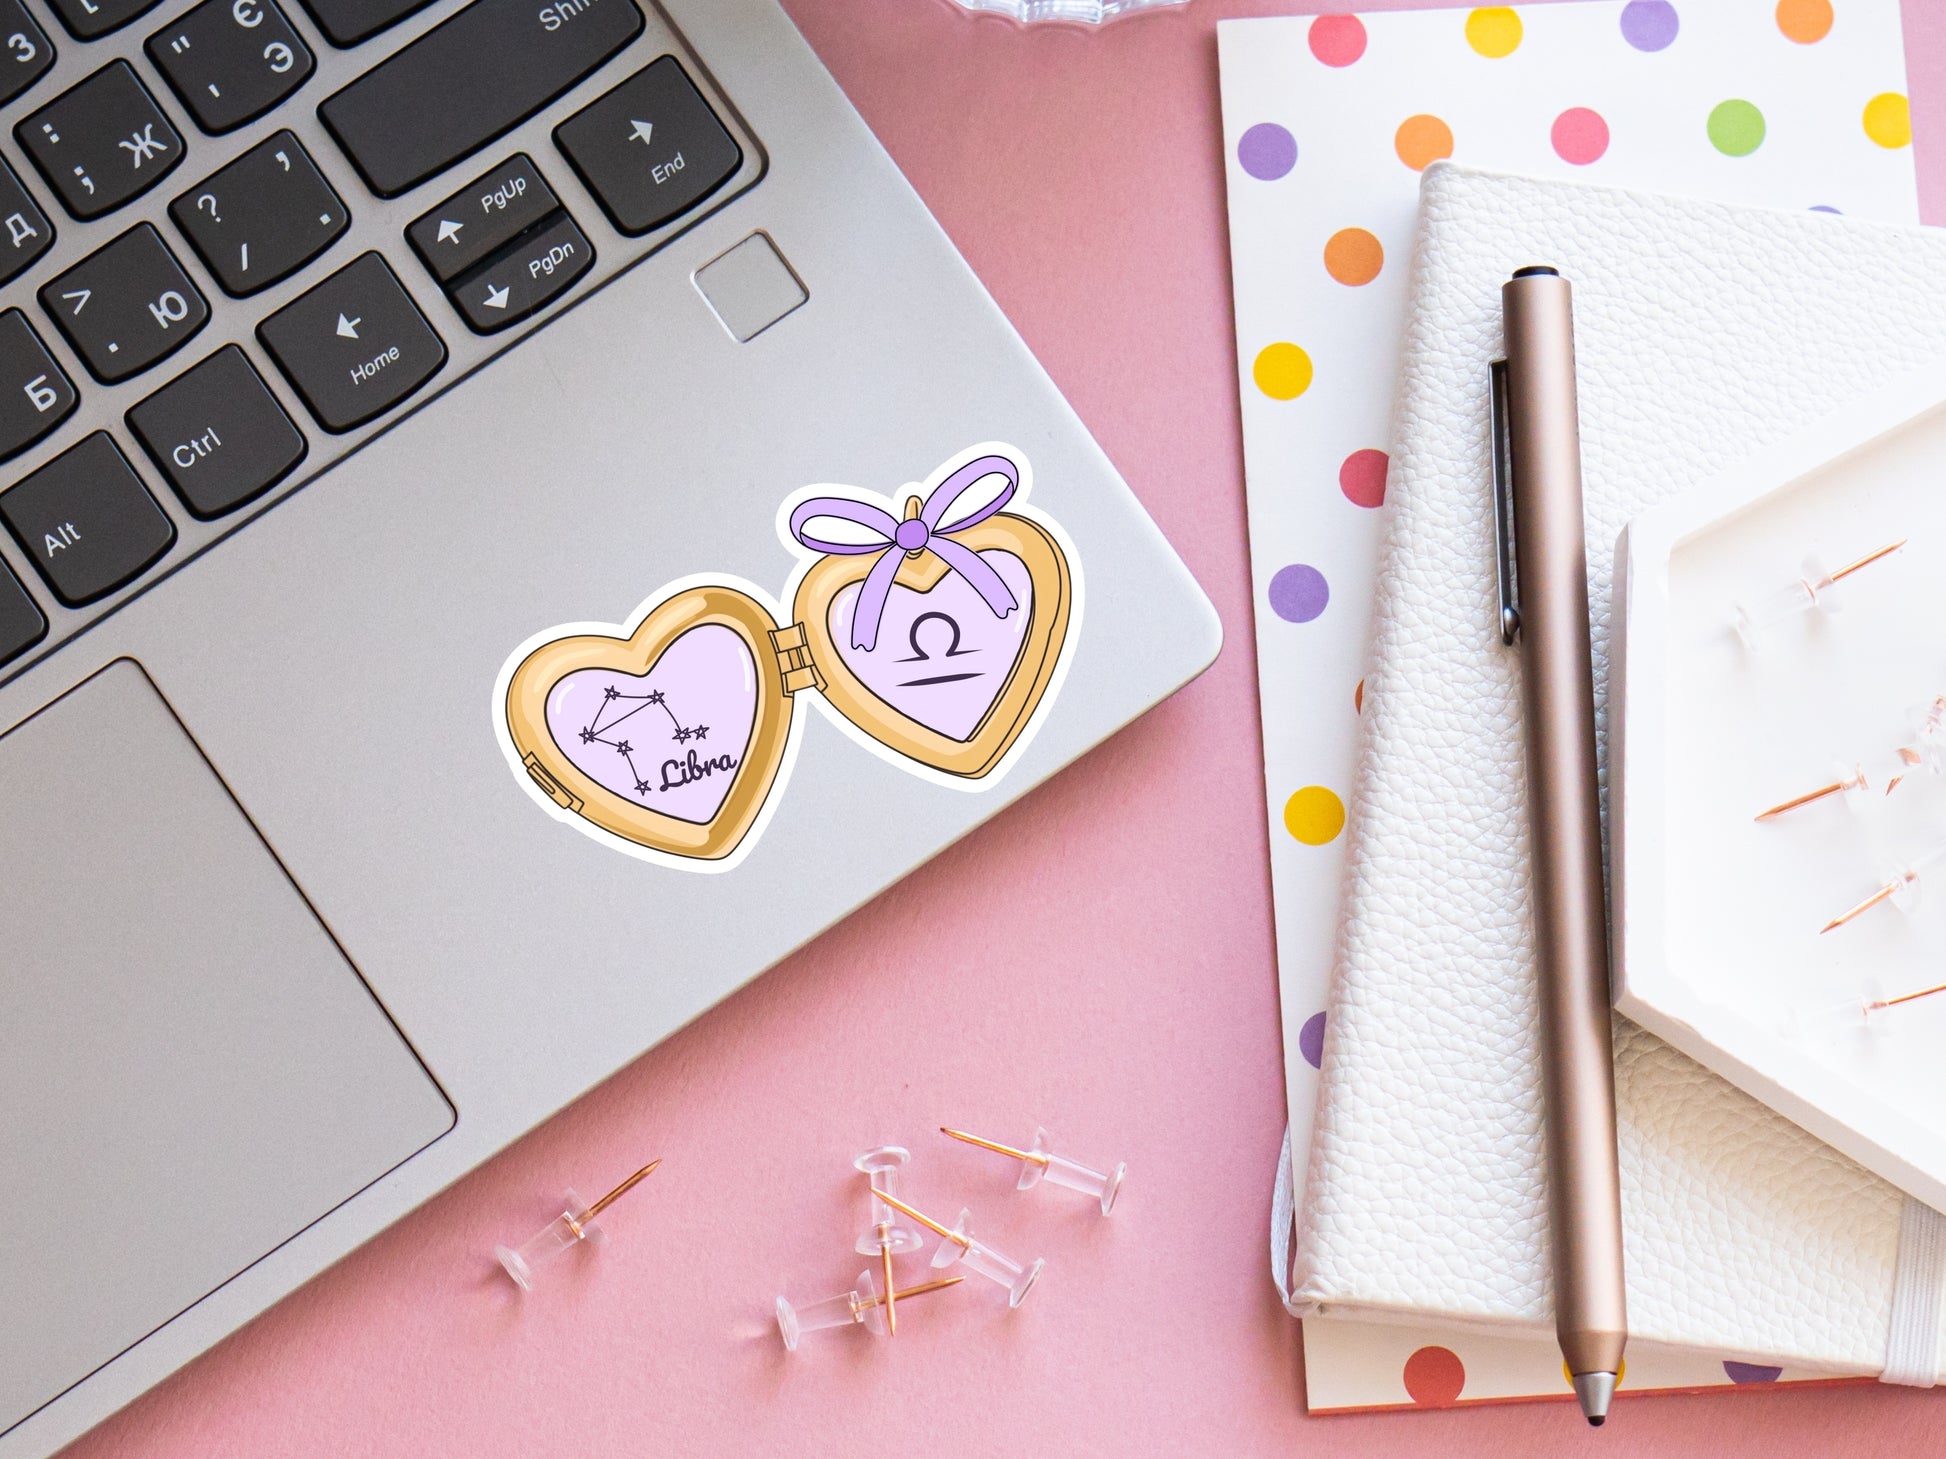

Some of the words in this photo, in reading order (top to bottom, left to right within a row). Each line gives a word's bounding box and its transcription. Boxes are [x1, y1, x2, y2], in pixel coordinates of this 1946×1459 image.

[263, 42, 294, 73] Э
[118, 123, 168, 169] Ж
[651, 151, 686, 185] End
[197, 194, 222, 223] ?
[480, 175, 527, 214] PgUp
[5, 212, 38, 248] Д
[528, 242, 575, 279] PgDn
[148, 291, 188, 329] Ю
[350, 346, 400, 385] Home
[23, 374, 58, 413] Б
[172, 427, 222, 468] Ctrl
[44, 522, 82, 558] Alt
[659, 748, 738, 793] Libra
